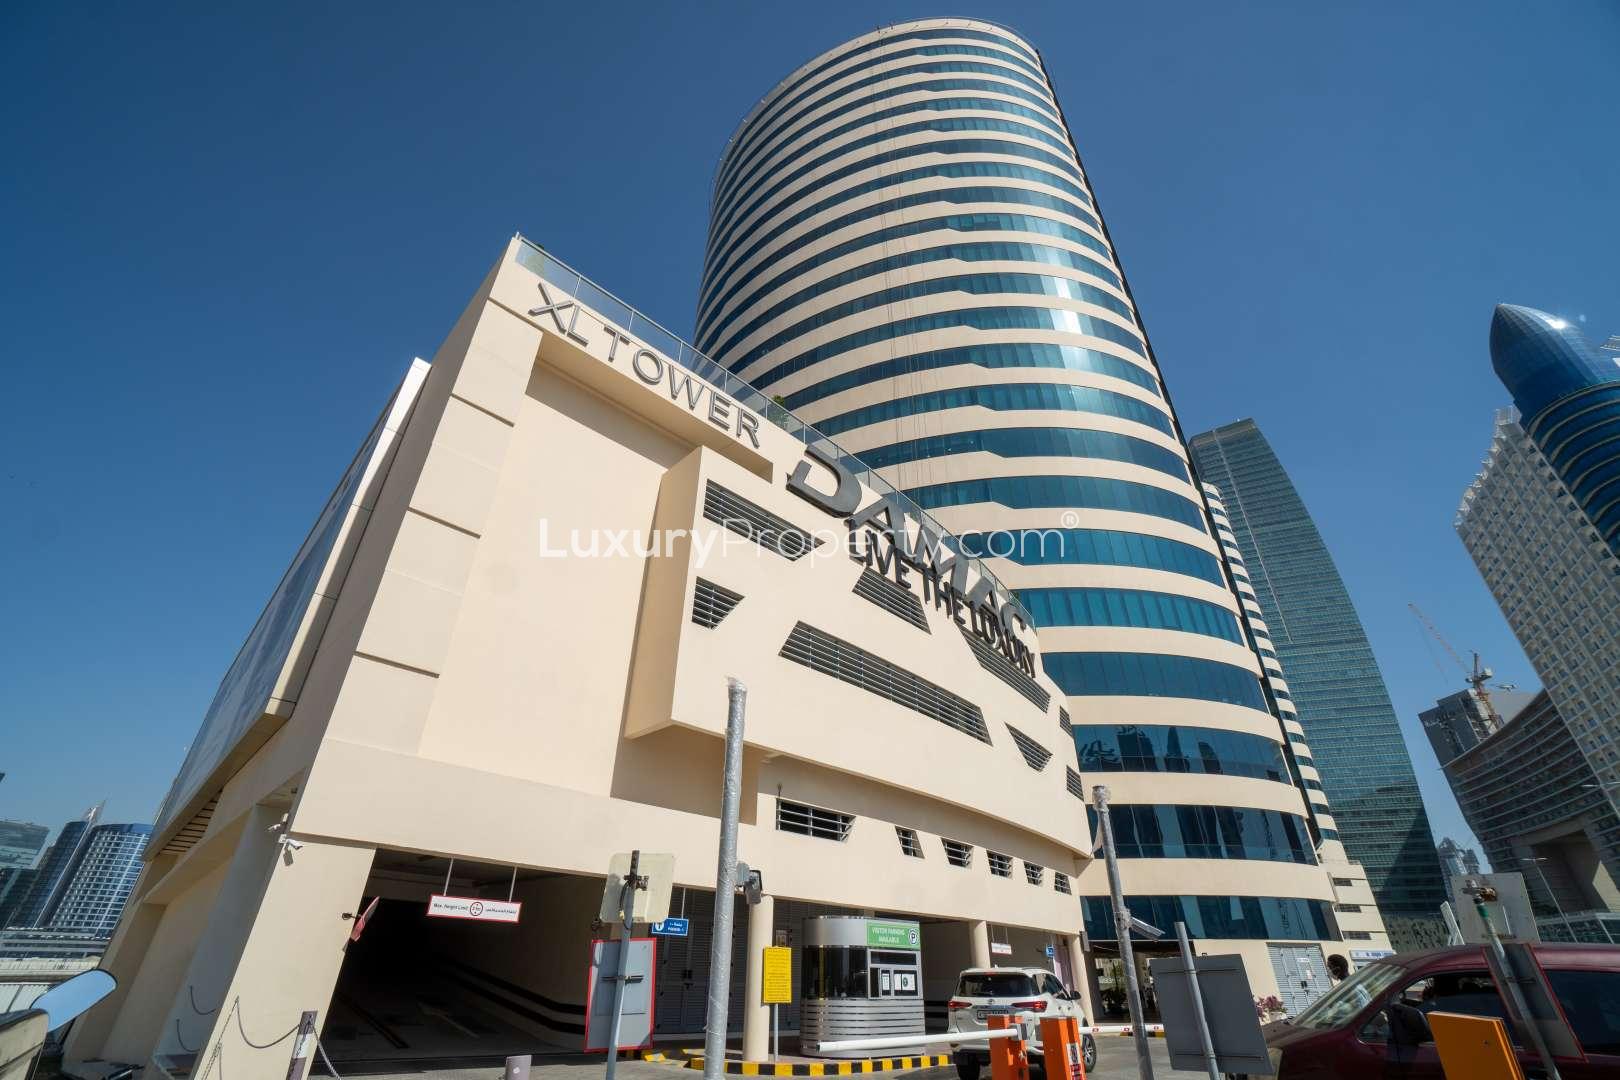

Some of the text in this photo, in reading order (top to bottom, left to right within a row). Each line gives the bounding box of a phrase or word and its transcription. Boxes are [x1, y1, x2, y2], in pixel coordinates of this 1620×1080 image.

[528, 282, 760, 449] XL TOWER
[786, 445, 1034, 642] DAMAC
[848, 519, 1036, 679] LIVE THE LUXURY
